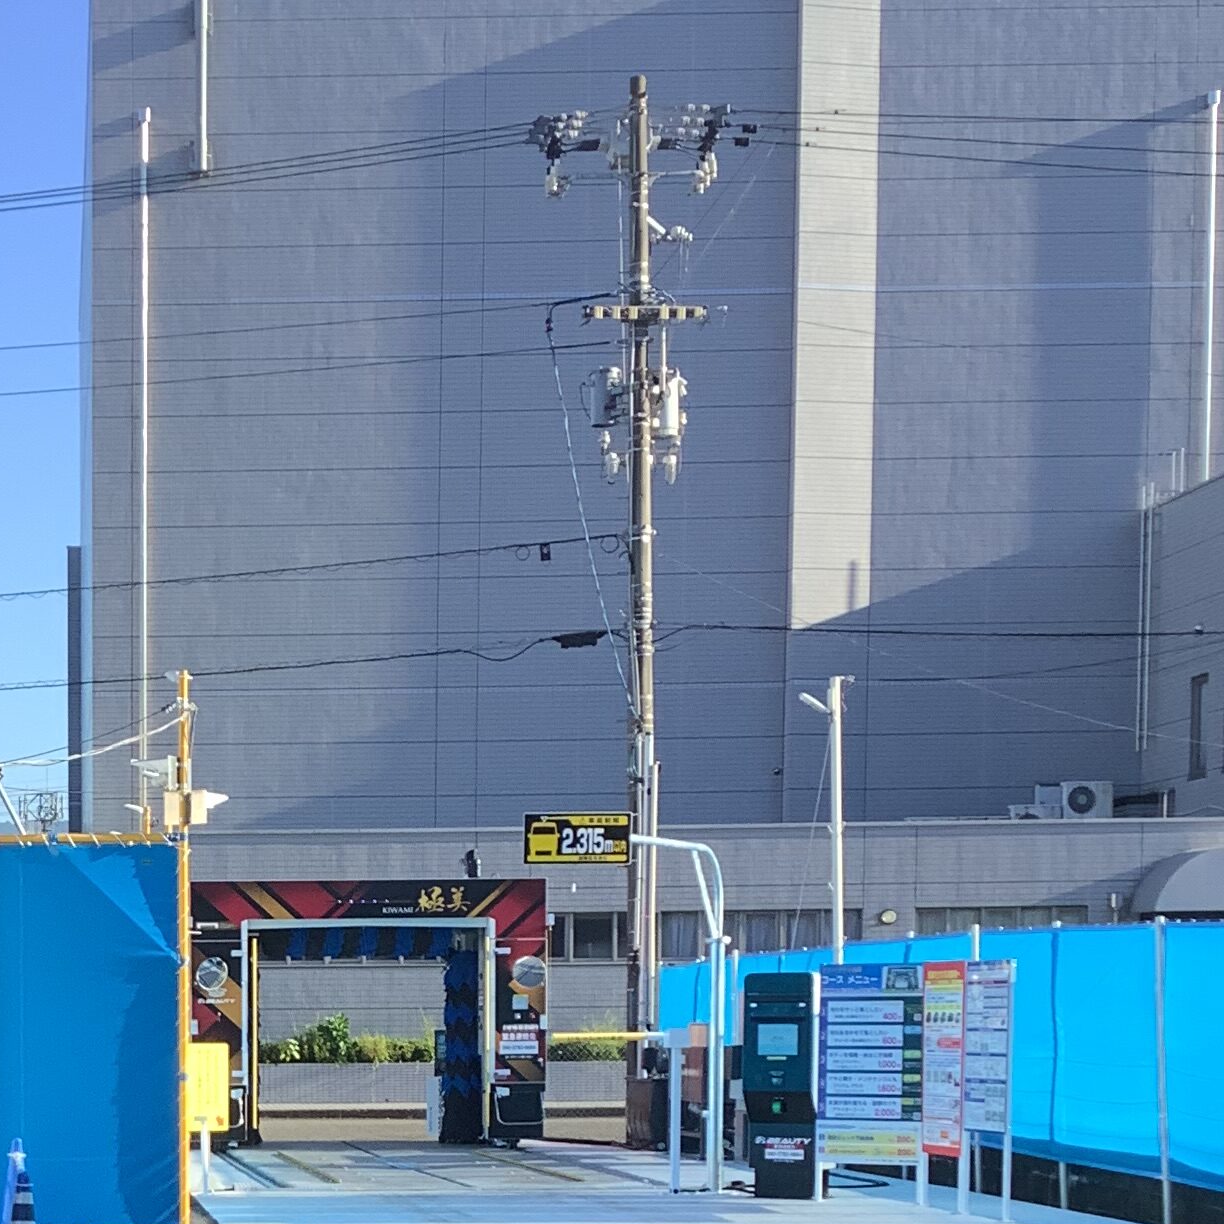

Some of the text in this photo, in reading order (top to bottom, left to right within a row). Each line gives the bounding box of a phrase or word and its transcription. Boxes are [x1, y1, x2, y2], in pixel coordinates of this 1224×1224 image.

[382, 886, 471, 914] KIWAMI 極美
[847, 975, 878, 985] メニュー
